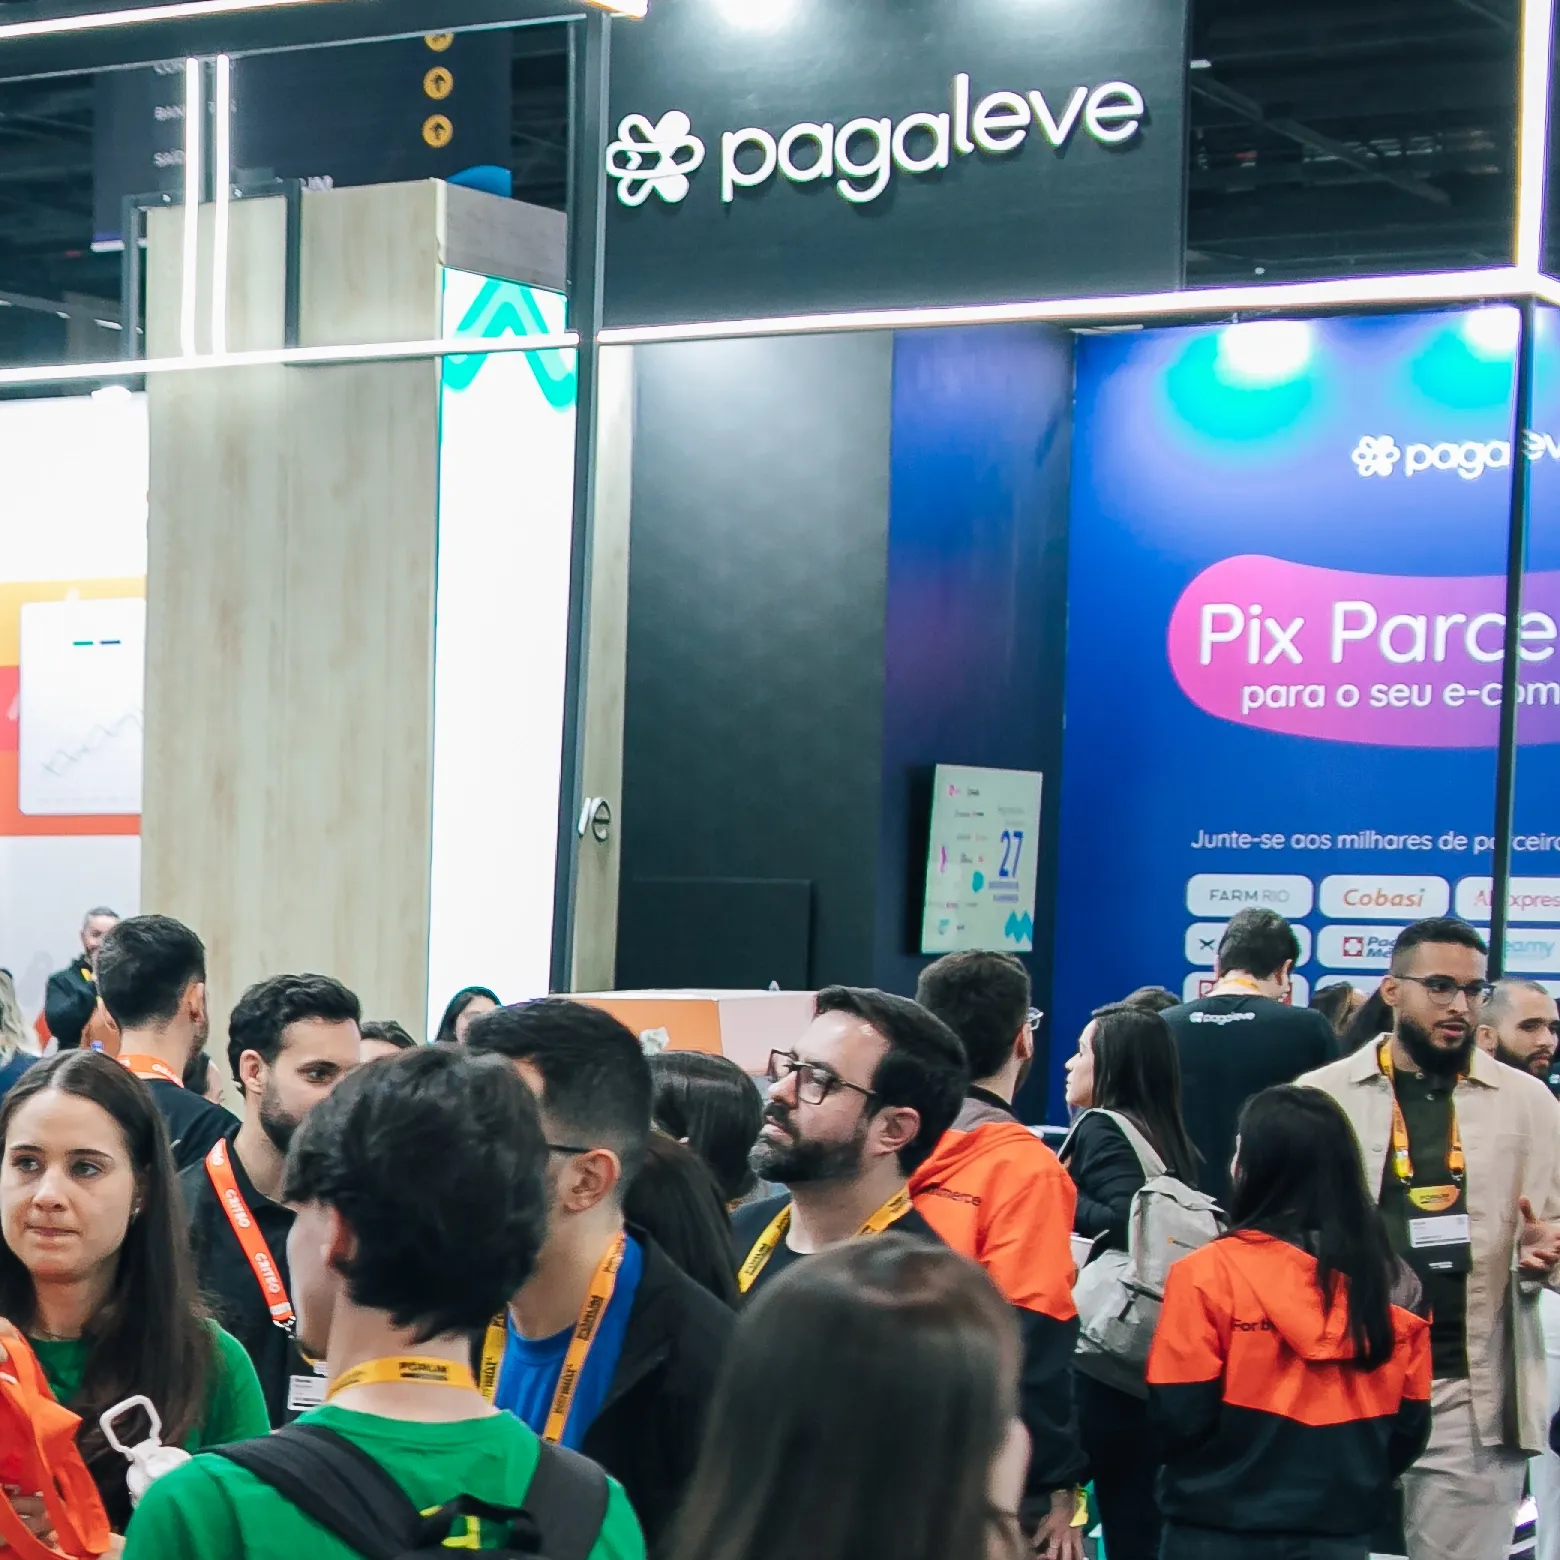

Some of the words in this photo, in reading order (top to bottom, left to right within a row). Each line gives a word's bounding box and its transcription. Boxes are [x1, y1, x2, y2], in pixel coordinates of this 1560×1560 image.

[721, 72, 1145, 203] pagaleve
[1199, 602, 1305, 665] Pix
[1240, 682, 1326, 715] para
[1335, 683, 1360, 708] o
[1369, 683, 1432, 709] seu
[998, 829, 1024, 878] 27
[1190, 829, 1286, 850] Junte-se
[1291, 833, 1332, 850] aos
[1337, 830, 1433, 850] milhares
[1438, 831, 1468, 851] de
[1209, 889, 1258, 902] FARM
[1262, 889, 1290, 903] RIO
[1343, 887, 1426, 907] Cobasi
